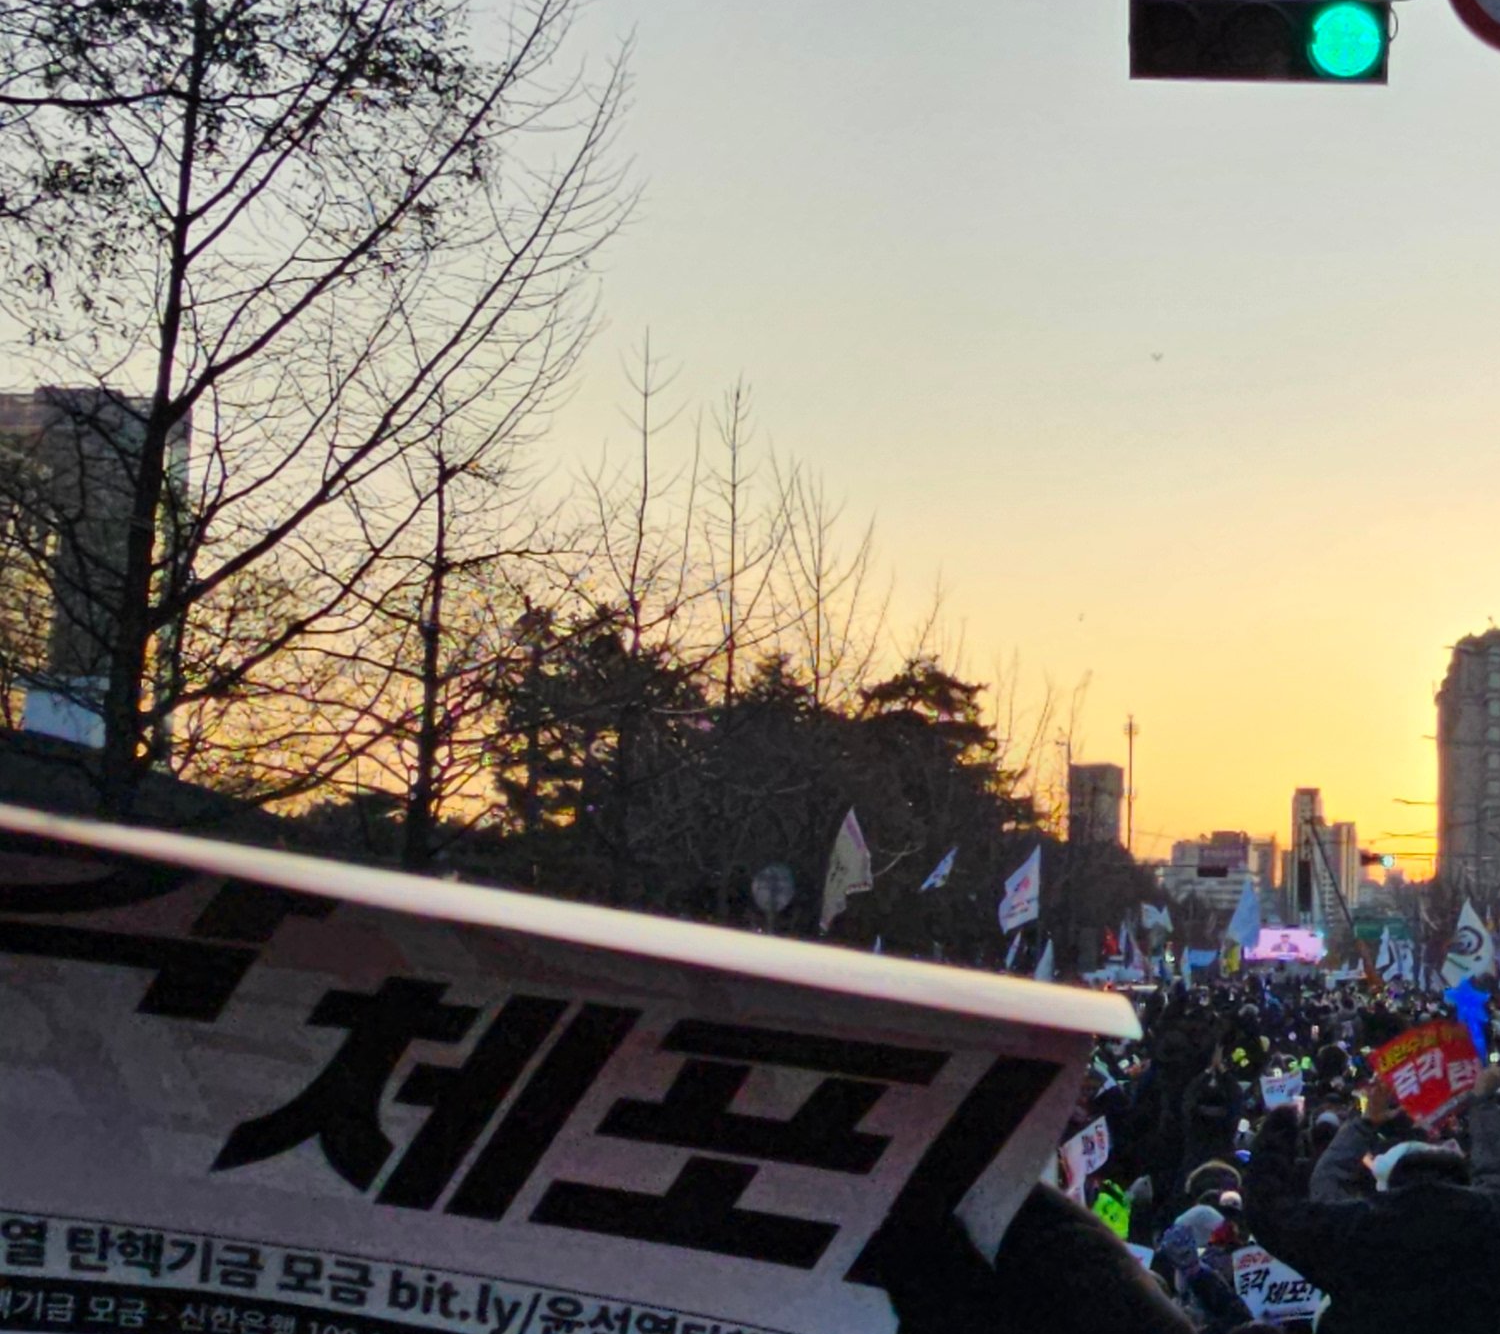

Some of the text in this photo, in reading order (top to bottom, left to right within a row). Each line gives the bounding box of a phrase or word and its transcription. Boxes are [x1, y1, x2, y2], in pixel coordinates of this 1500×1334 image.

[0, 1217, 48, 1268] 열
[66, 1224, 265, 1291] 탄핵기금
[276, 1251, 375, 1308] 모금
[86, 1293, 150, 1329] 모금
